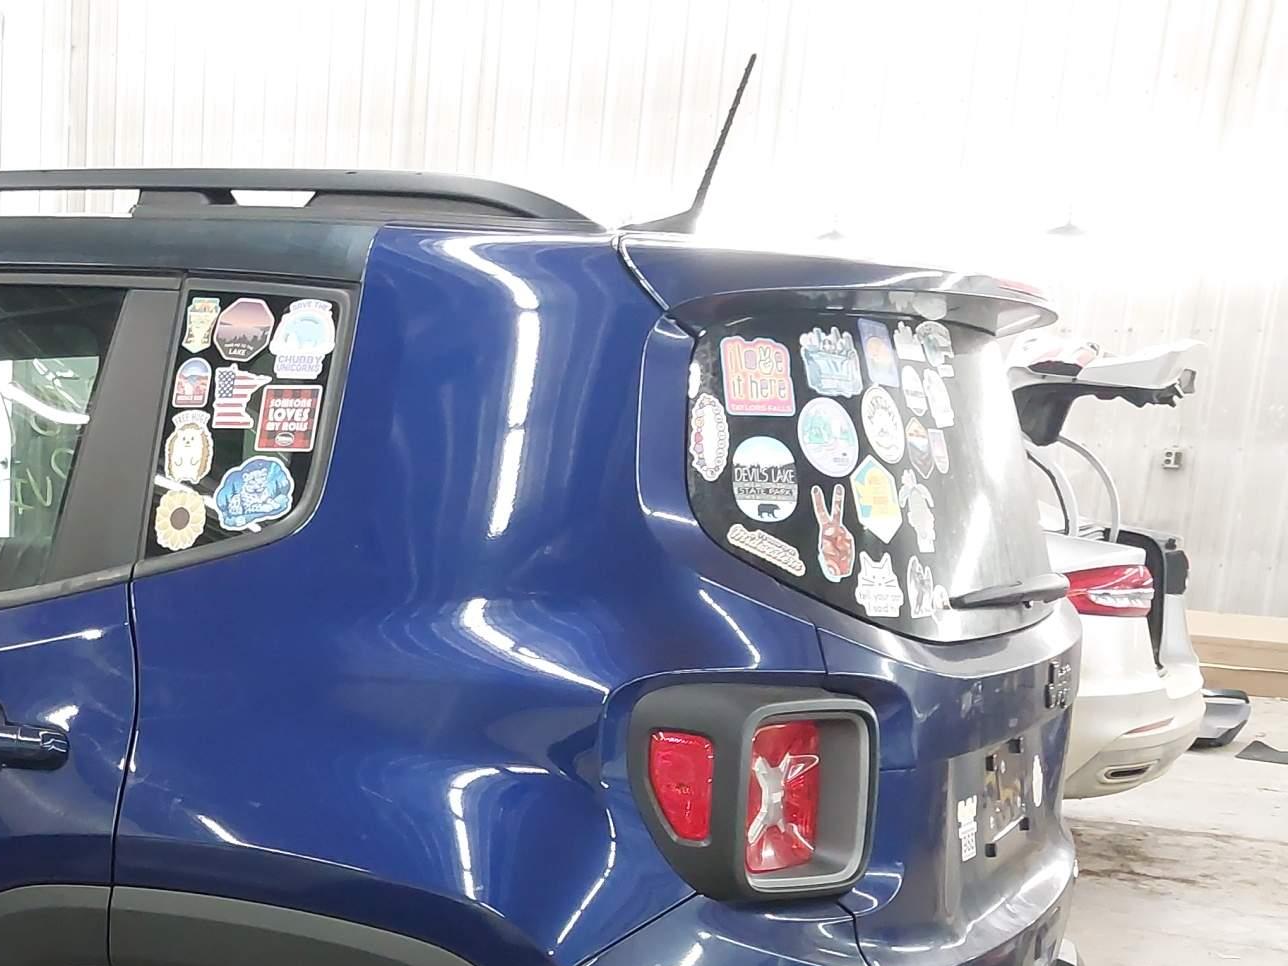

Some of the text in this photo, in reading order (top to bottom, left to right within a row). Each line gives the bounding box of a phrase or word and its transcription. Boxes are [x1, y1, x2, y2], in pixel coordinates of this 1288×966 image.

[228, 348, 248, 356] LAKE
[268, 408, 310, 422] LOVES
[771, 468, 796, 483] LAKE
